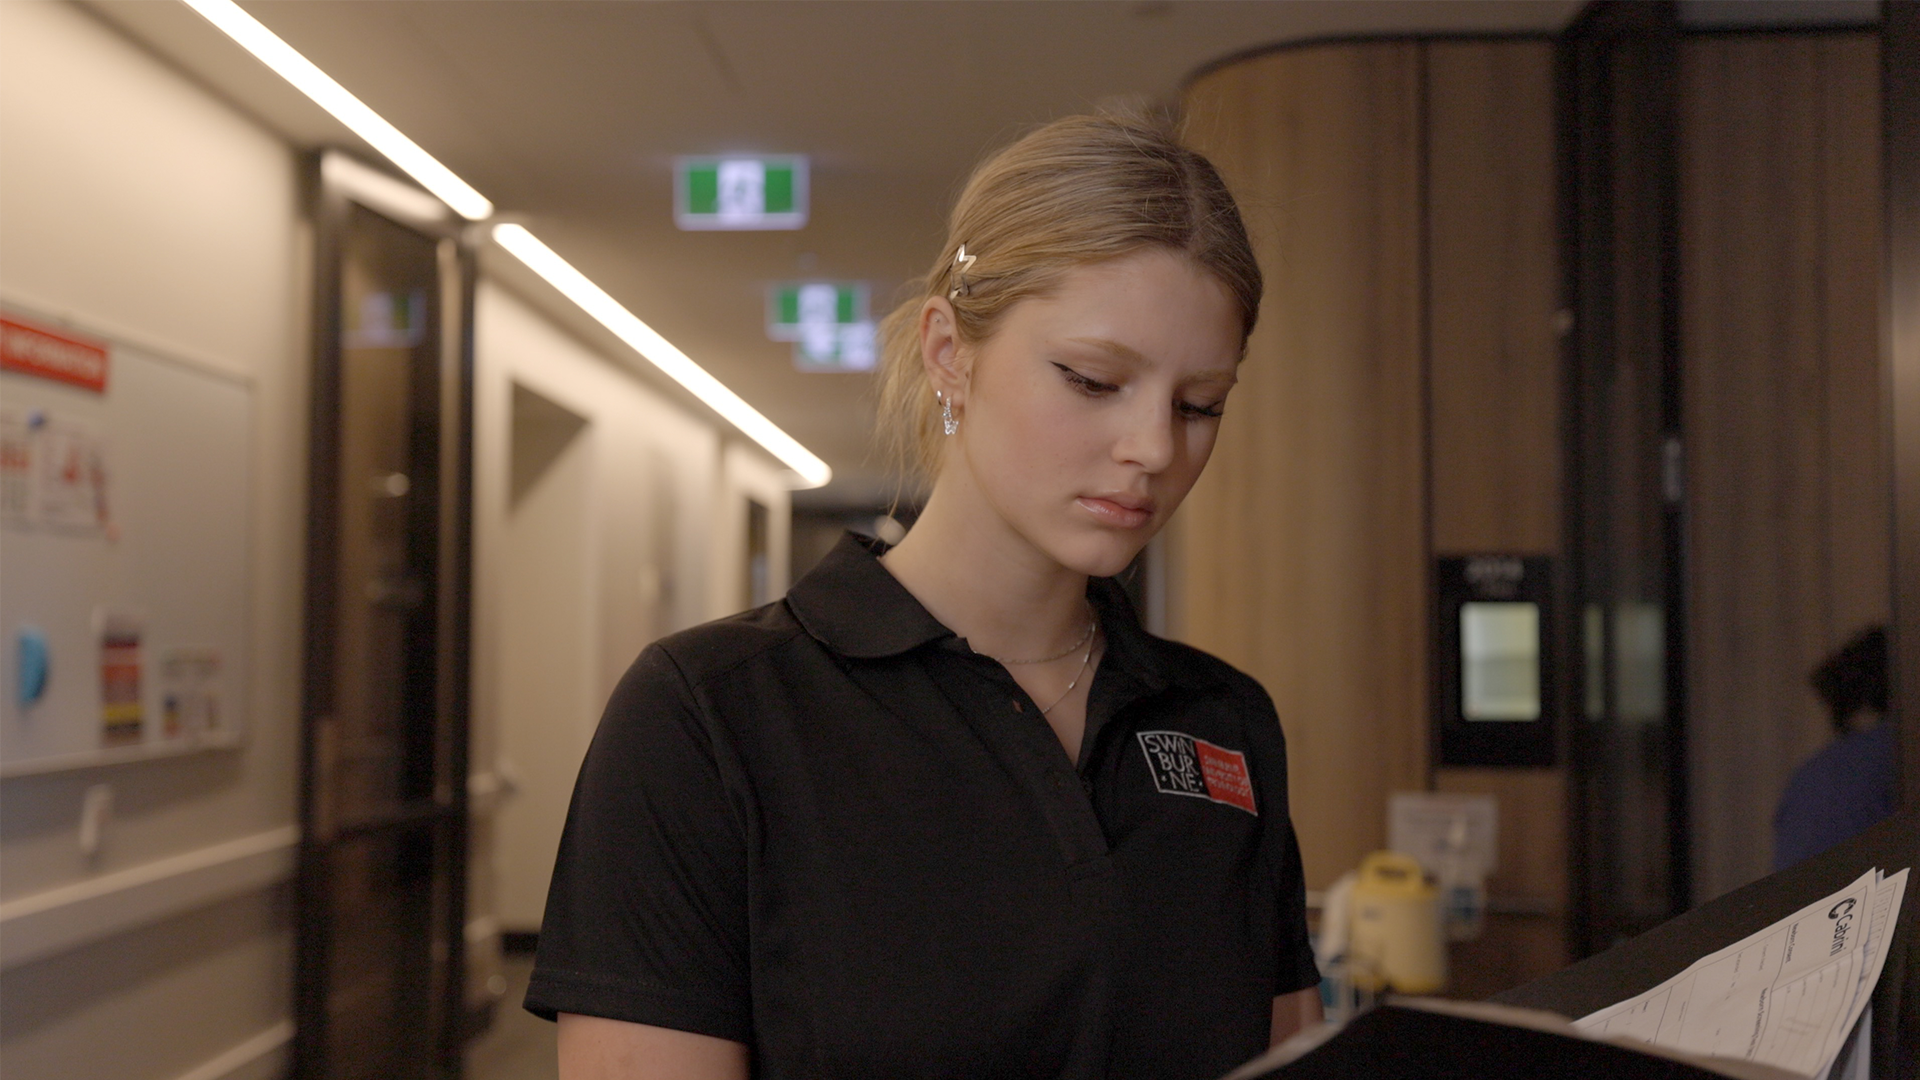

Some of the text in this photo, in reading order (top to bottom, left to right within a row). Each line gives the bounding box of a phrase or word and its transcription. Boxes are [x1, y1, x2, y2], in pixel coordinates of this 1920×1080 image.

[1145, 735, 1196, 758] SWIN
[1158, 752, 1199, 775] BUR
[1830, 914, 1853, 957] Cabrini
